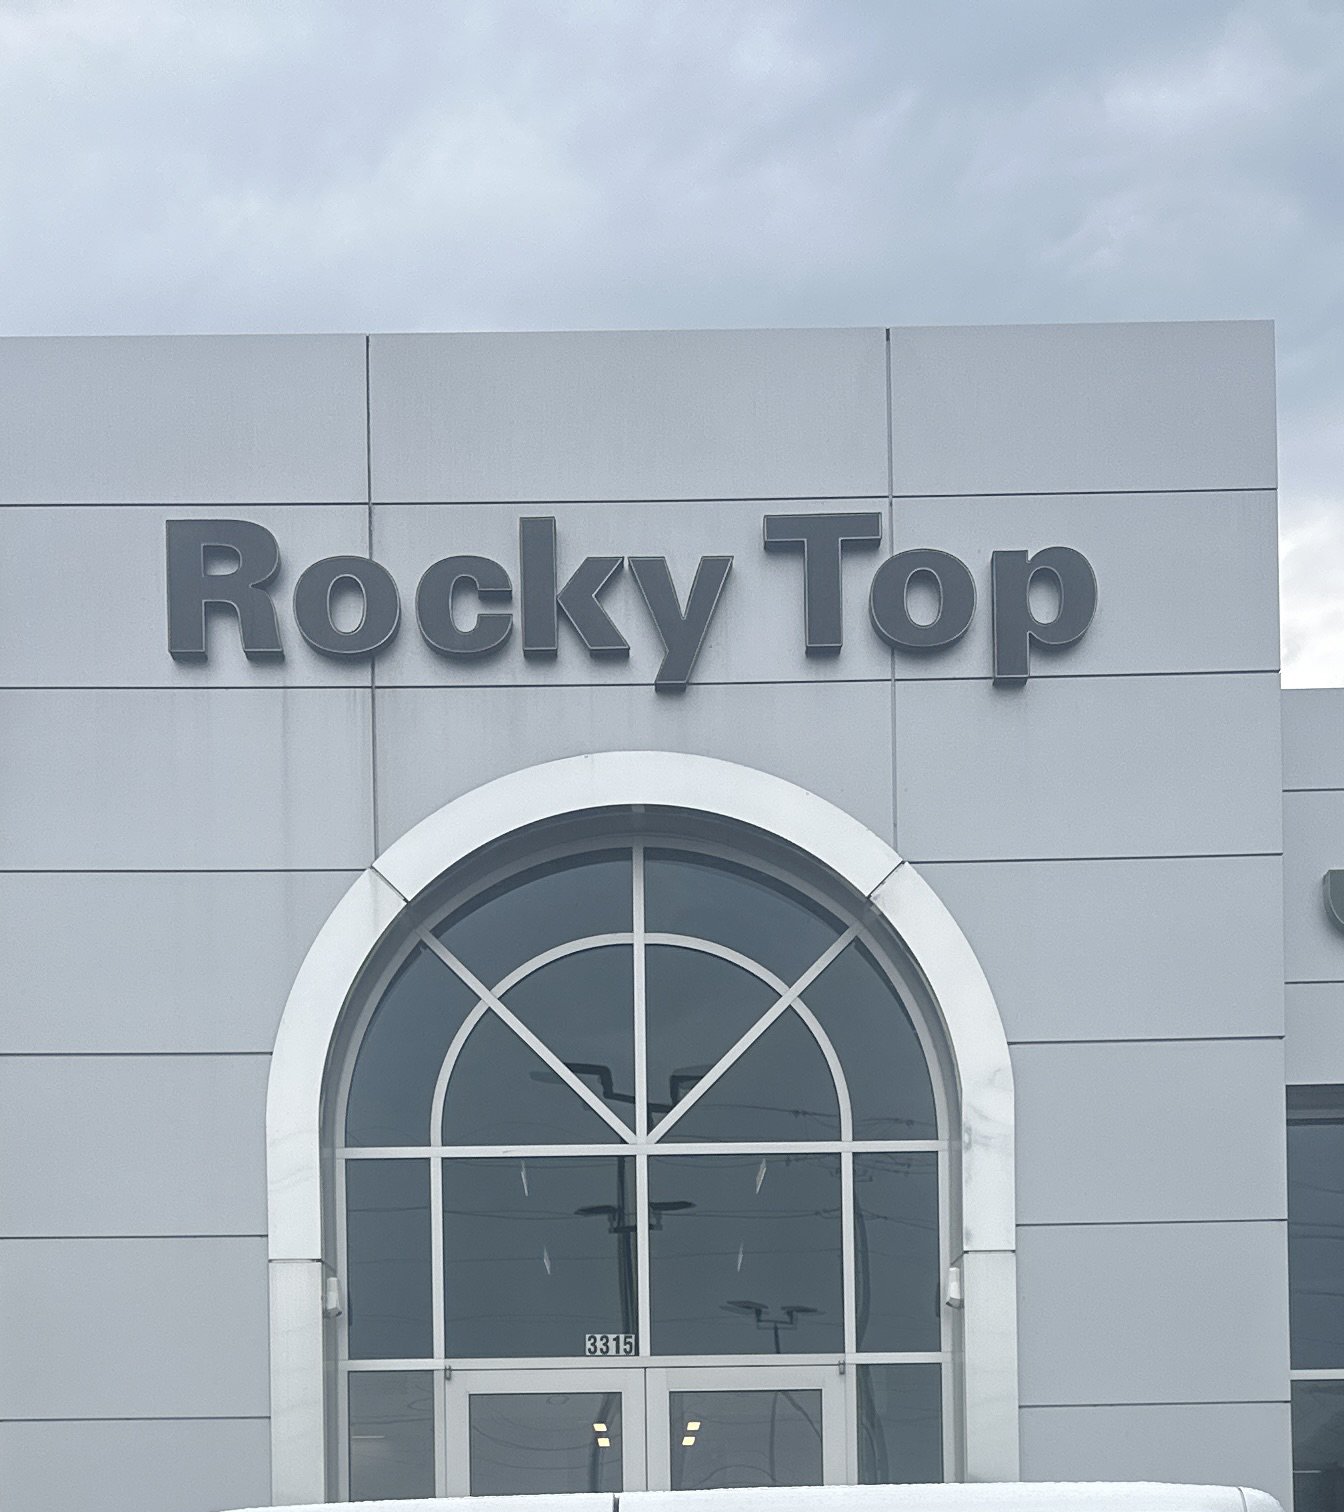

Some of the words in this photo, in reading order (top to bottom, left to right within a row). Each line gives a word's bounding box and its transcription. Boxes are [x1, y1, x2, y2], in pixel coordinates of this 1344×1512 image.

[164, 516, 735, 692] Rocky
[763, 511, 1098, 686] Top
[586, 1334, 634, 1355] 3315
